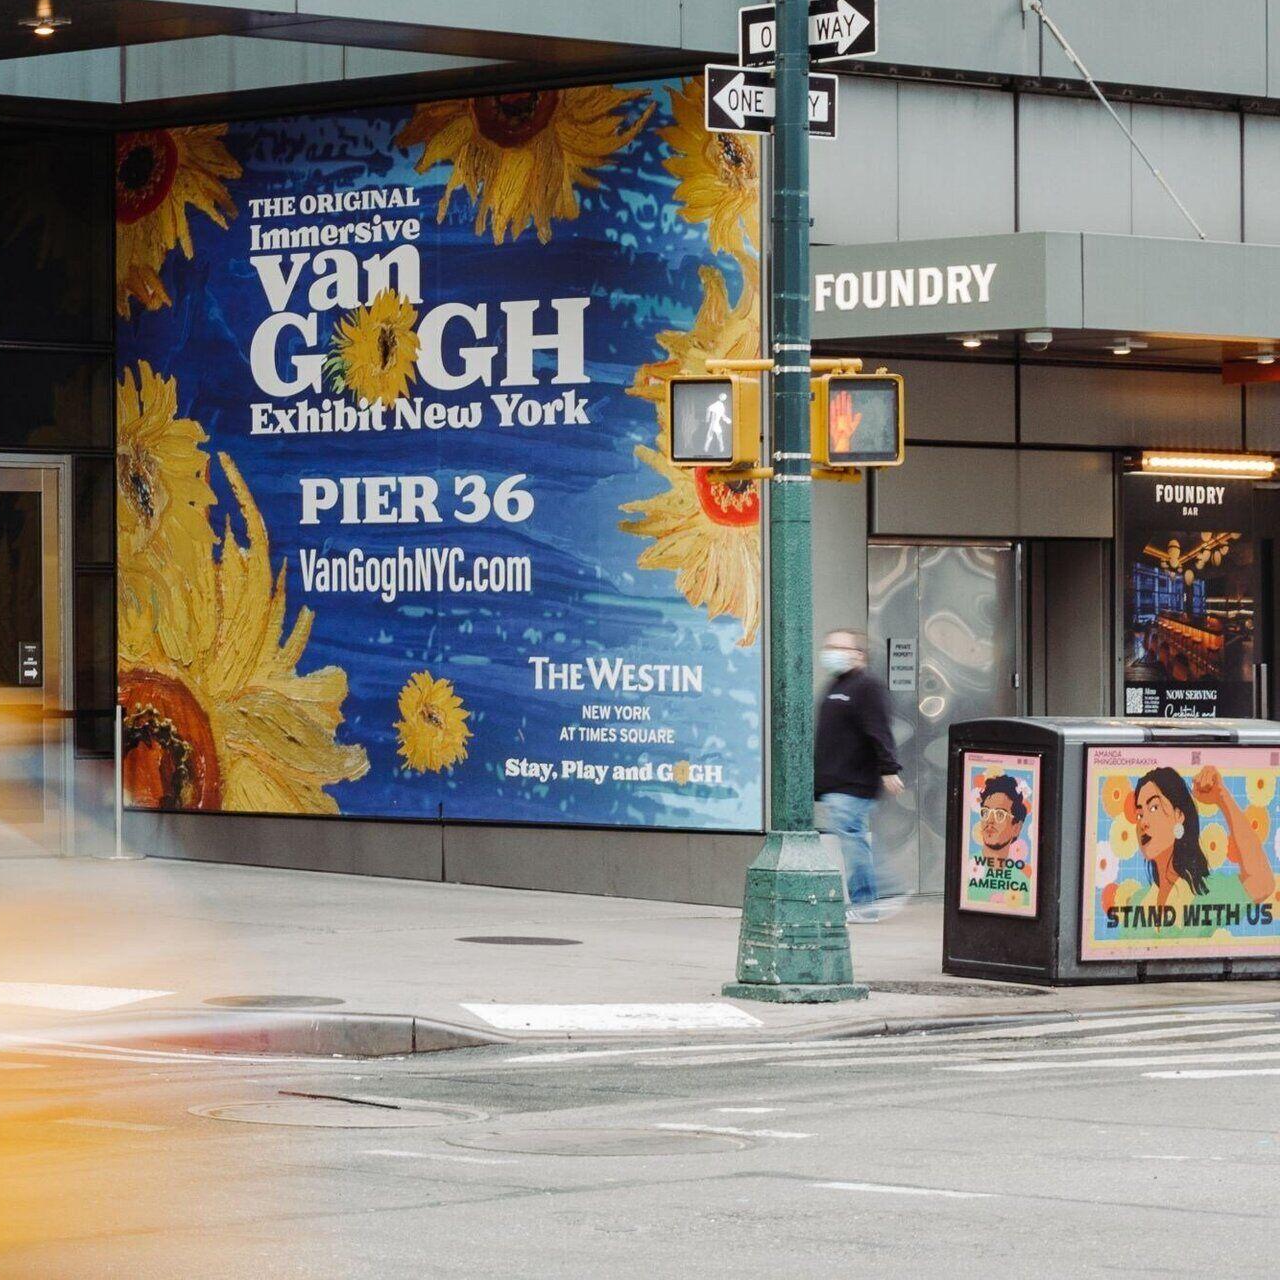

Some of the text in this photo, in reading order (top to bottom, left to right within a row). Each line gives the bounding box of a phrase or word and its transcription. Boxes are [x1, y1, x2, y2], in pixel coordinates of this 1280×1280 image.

[816, 14, 855, 40] WAY
[728, 88, 764, 113] ONE
[249, 187, 420, 218] THE ORIGINAL
[249, 215, 420, 251] Immersive
[249, 244, 424, 312] van
[815, 263, 997, 311] FOUNDRY
[249, 390, 591, 434] Exhibit New York
[299, 473, 535, 525] PIER 36
[1155, 484, 1225, 505] FOUNDRY
[1182, 507, 1199, 516] BAR
[299, 546, 532, 603] VanGoghNYC.com
[528, 657, 703, 692] THE WESTIN
[1166, 690, 1217, 700] NOW SERVING
[582, 705, 651, 721] NEW YORK
[1201, 705, 1217, 718] and
[559, 727, 675, 744] AT TIMES SQUARE
[505, 757, 558, 782] Stay,
[561, 760, 609, 785] Play
[612, 761, 653, 781] and
[974, 856, 1025, 870] WE TOO
[986, 868, 1011, 879] ARE
[969, 878, 1028, 892] AMERICA
[1107, 904, 1273, 928] STAND WITH US
